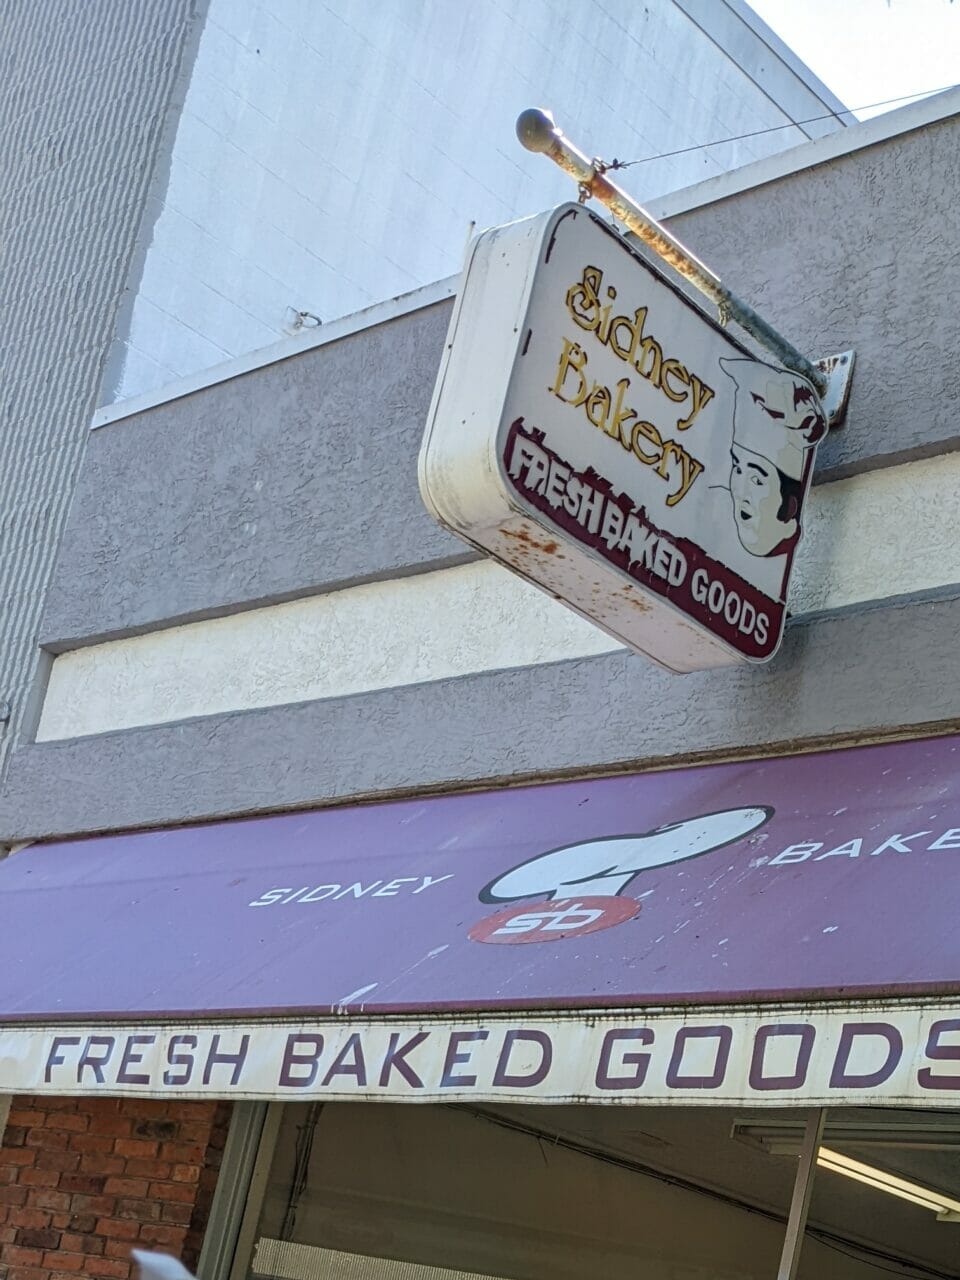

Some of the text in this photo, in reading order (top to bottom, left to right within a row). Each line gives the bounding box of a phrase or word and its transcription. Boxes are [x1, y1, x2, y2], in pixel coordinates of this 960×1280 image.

[548, 335, 704, 507] Bakery
[566, 265, 715, 429] Sidney
[508, 434, 768, 646] FRESH BAKED GOODS
[248, 873, 454, 907] SIDNEY
[44, 1034, 250, 1085] FRESH
[278, 1029, 553, 1089] BAKED
